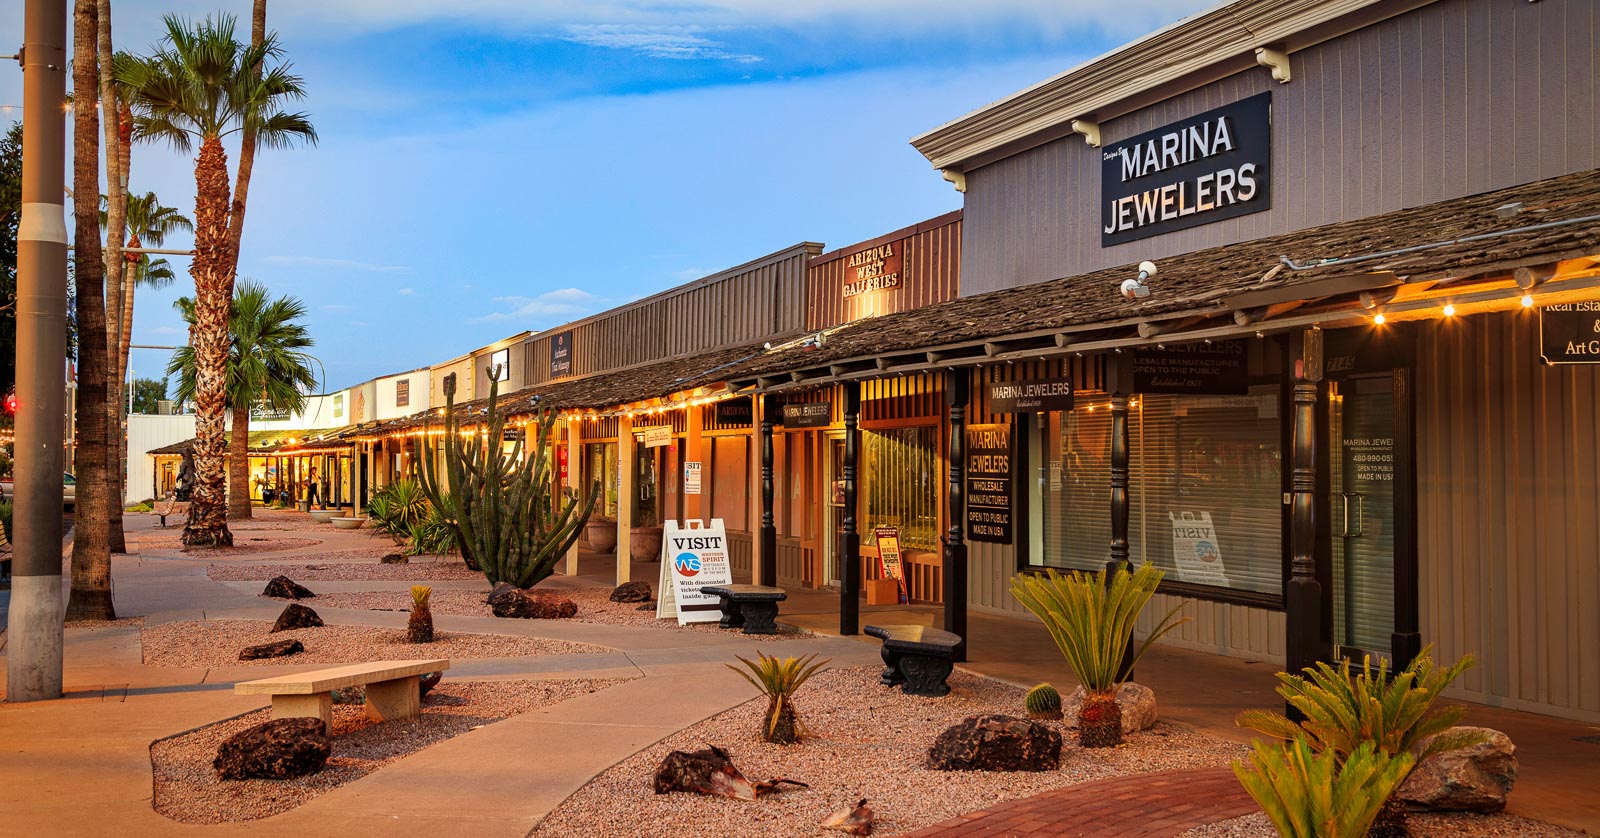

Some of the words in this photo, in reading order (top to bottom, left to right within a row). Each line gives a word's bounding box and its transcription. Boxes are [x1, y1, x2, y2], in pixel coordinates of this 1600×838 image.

[1121, 115, 1233, 182] MARINA
[1104, 162, 1257, 234] JEWELERS
[848, 243, 893, 268] ARIZONA
[856, 260, 884, 280] WEST
[843, 272, 897, 298] GALLERIES
[1169, 340, 1243, 354] JEWELERS
[1565, 340, 1586, 355] Art
[1134, 357, 1166, 365] LESALE
[1169, 358, 1240, 367] MANUFACTURER
[1133, 365, 1156, 373] OPEN
[1171, 366, 1188, 374] THE
[1189, 366, 1221, 375] PUBLIC
[992, 385, 1023, 400] MARINA
[1024, 382, 1069, 397] JEWELERS
[721, 406, 749, 416] ARIZONA
[784, 407, 801, 418] MARINA
[802, 405, 827, 417] JEWELERS
[969, 431, 1008, 449] MARINA
[1343, 438, 1370, 446] MARINA
[968, 455, 1009, 473] JEWELERS
[973, 481, 1004, 492] WHOLESALE
[968, 494, 1009, 505] MANUFACTURER
[969, 512, 982, 521] OPEN
[983, 513, 990, 522] TO
[990, 513, 1008, 524] PUBLIC
[973, 525, 987, 535] MADE
[987, 526, 993, 535] IN
[993, 526, 1004, 536] USA
[673, 536, 722, 550] VISIT
